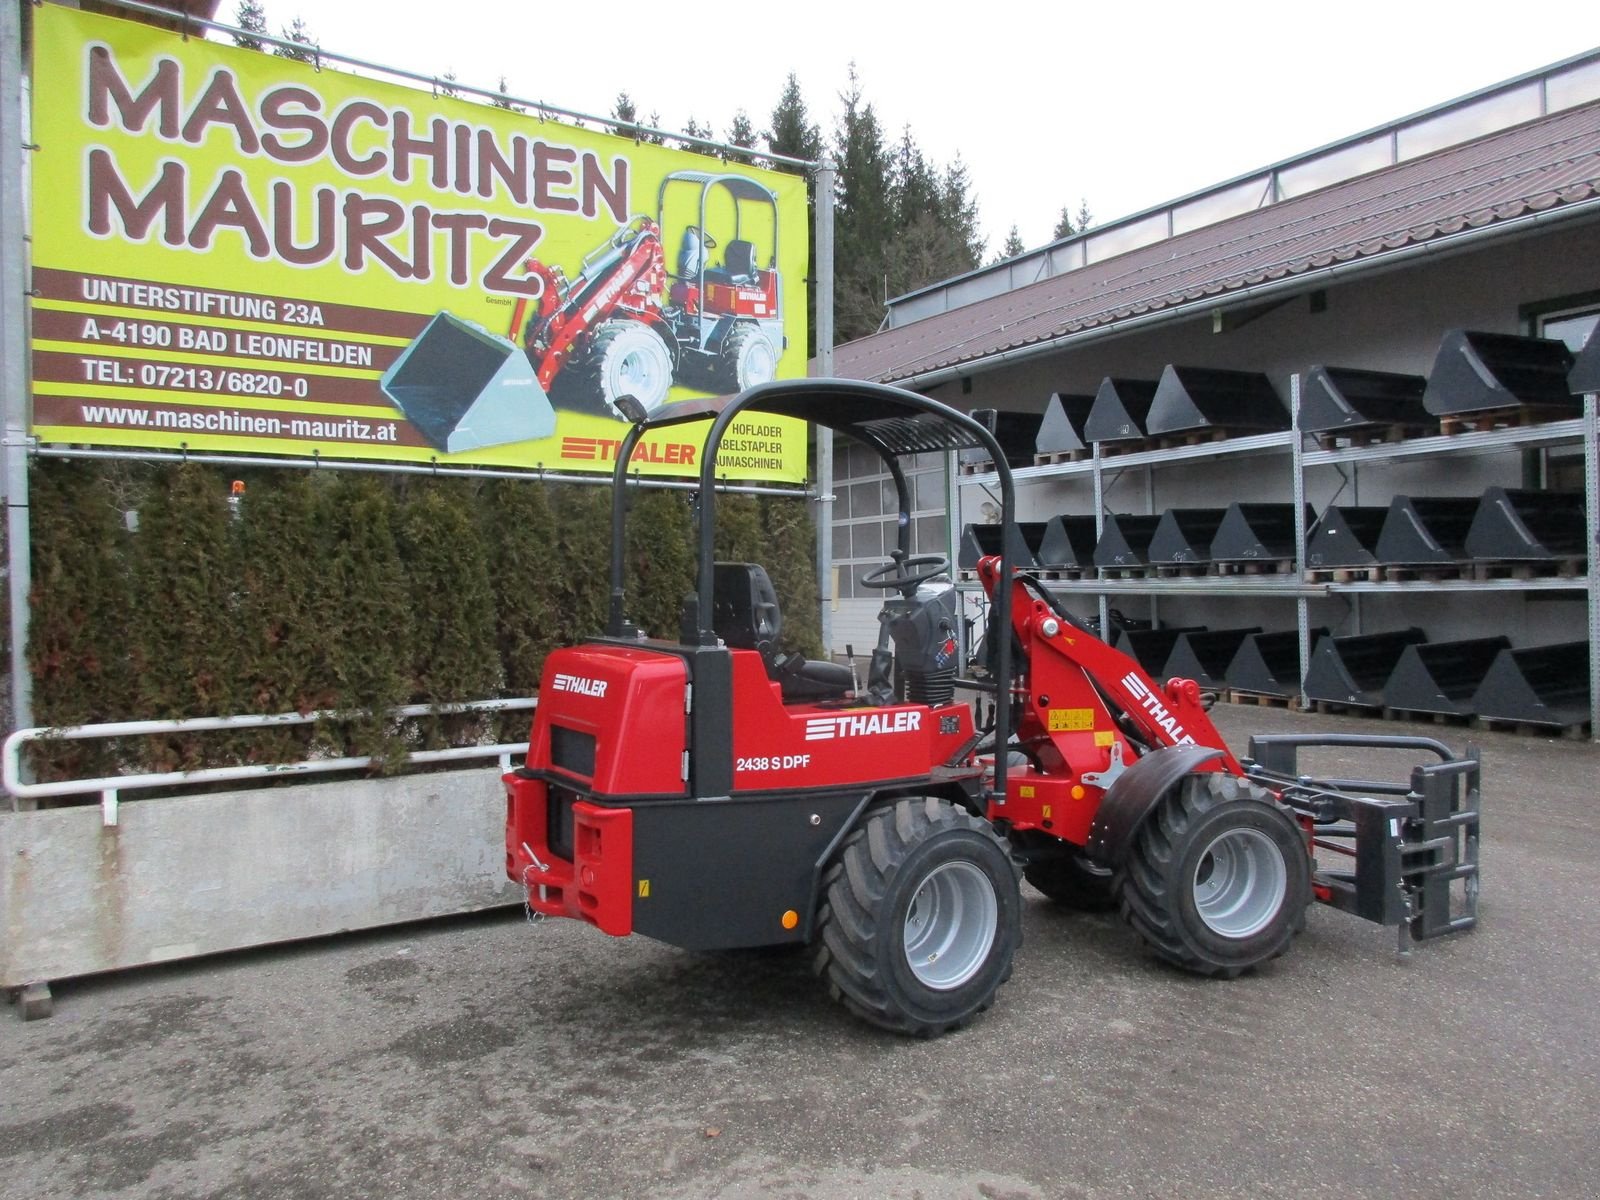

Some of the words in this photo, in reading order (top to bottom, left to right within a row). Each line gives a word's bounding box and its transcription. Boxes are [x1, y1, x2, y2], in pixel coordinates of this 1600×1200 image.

[87, 45, 628, 224] MASCHINEN
[87, 148, 542, 295] MAURITZ
[82, 277, 277, 321] UNTERSTIFTUNG
[282, 302, 325, 326] 23A
[81, 317, 172, 347] A-4190
[179, 327, 228, 352] BAD
[234, 332, 372, 367] LEONFELDEN
[81, 358, 135, 384] TEL:
[140, 364, 308, 398] 07213/6820-0
[81, 404, 397, 442] www.maschinen-mauritz.at
[732, 423, 782, 438] HOFLADER
[565, 674, 608, 698] THALER
[836, 711, 922, 738] THALER
[736, 756, 769, 772] 2438
[771, 756, 781, 771] S
[783, 754, 811, 770] DPF
